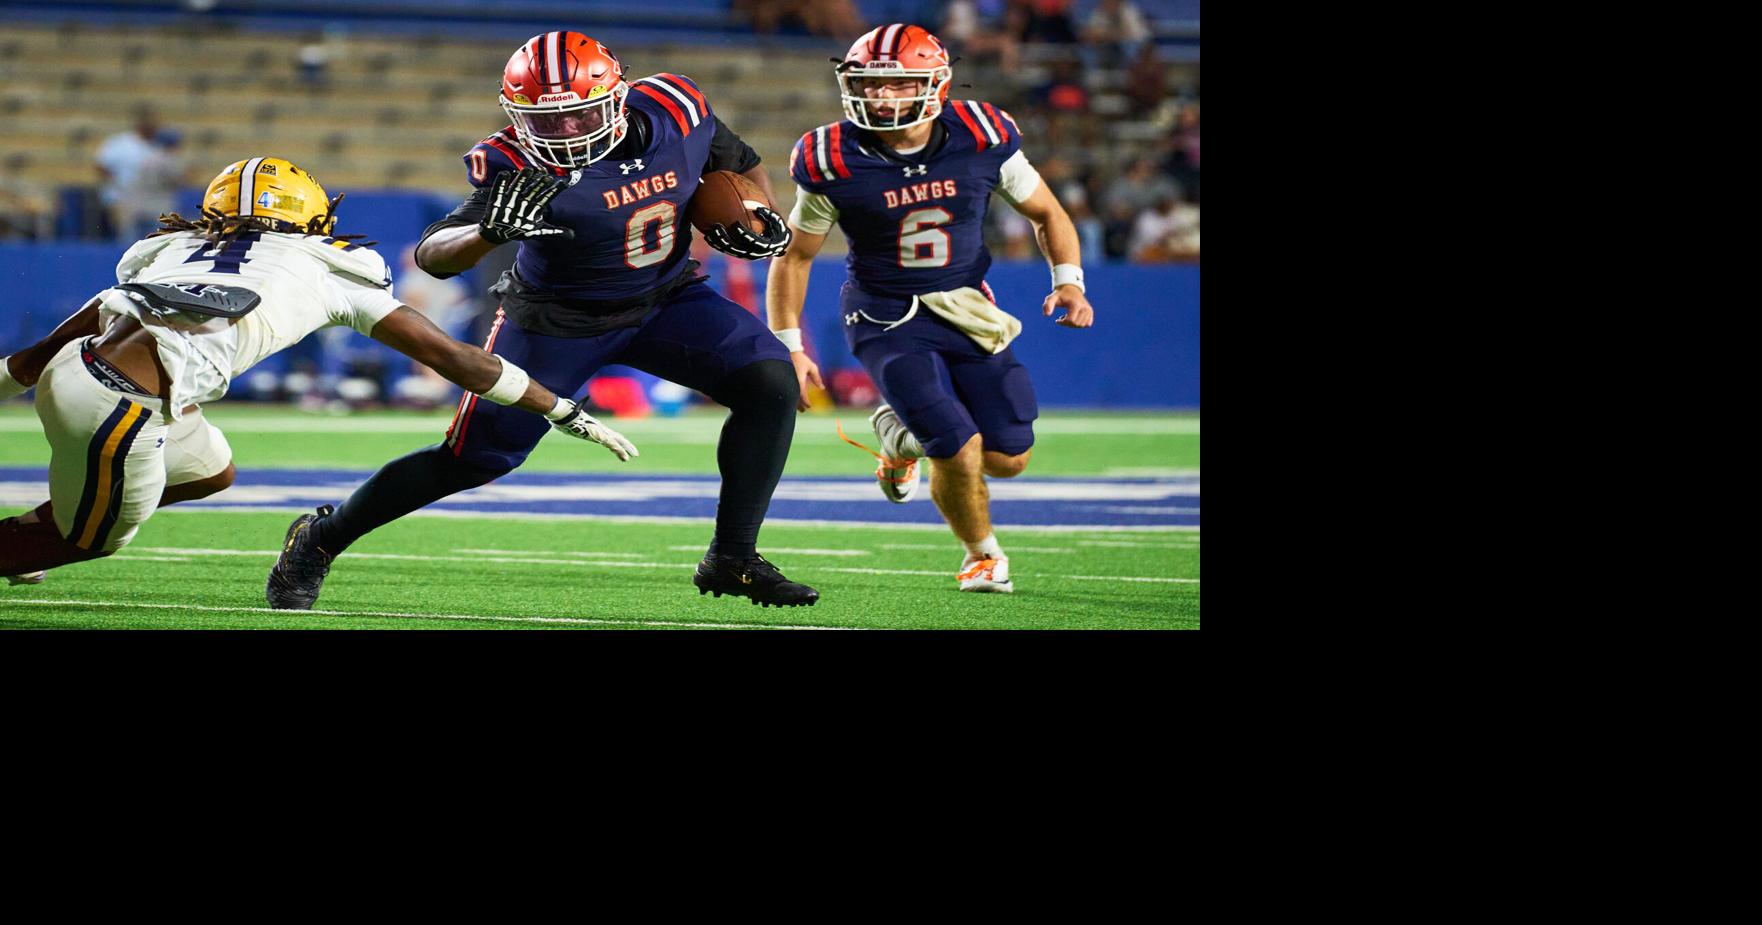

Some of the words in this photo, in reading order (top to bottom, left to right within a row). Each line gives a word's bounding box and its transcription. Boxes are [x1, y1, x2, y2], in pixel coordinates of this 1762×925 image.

[541, 94, 574, 103] Riddell
[471, 149, 487, 182] 0
[256, 192, 269, 208] 4
[602, 171, 678, 210] DAWGS
[882, 180, 957, 209] DAWGS
[182, 230, 262, 275] 4
[624, 200, 677, 270] 0
[897, 206, 953, 269] 6
